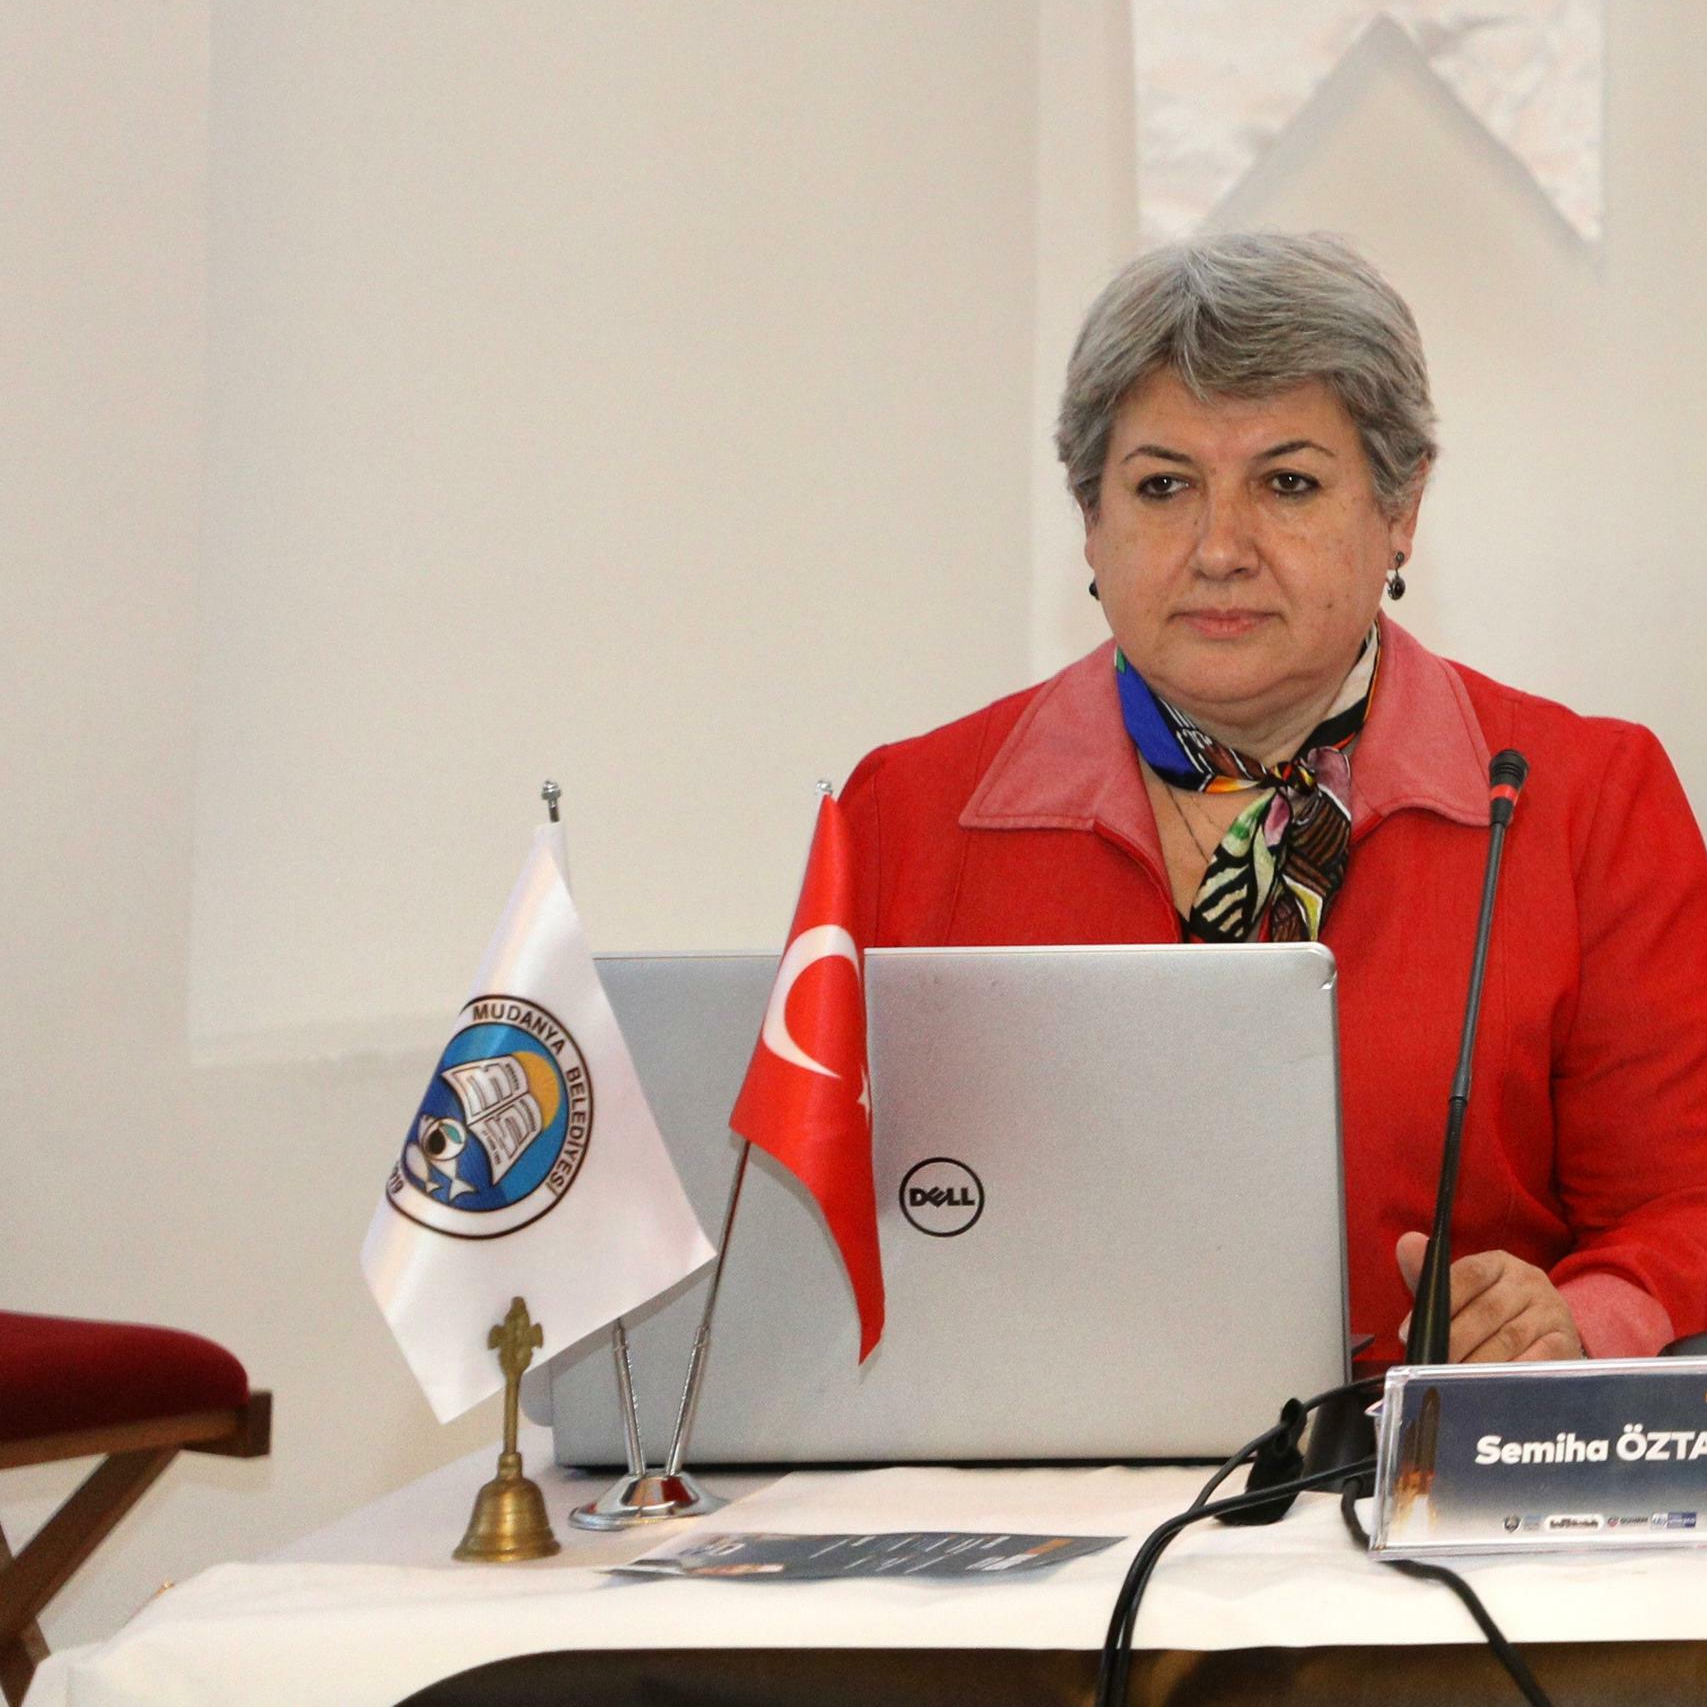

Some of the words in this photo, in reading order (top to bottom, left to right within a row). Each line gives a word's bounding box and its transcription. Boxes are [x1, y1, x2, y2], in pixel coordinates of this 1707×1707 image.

[472, 1004, 566, 1055] MUDANYA
[545, 1066, 587, 1195] BELEDİYESİ
[909, 1186, 975, 1207] DELL
[1475, 1432, 1609, 1466] Semiha
